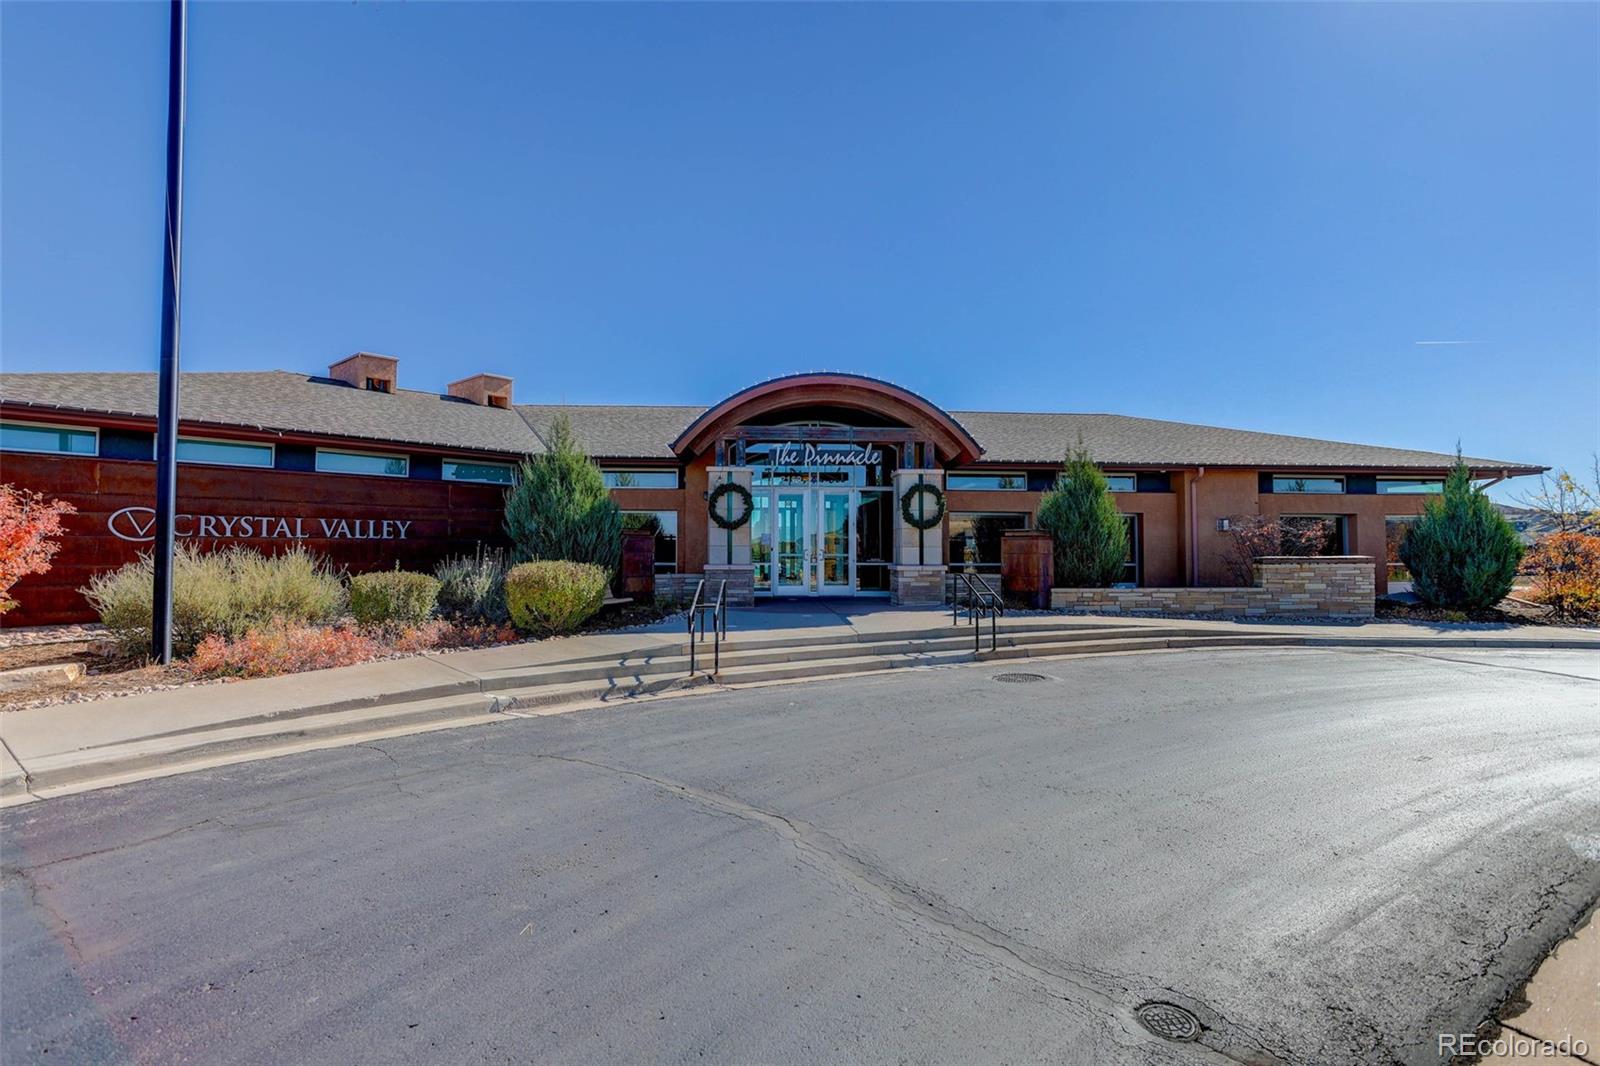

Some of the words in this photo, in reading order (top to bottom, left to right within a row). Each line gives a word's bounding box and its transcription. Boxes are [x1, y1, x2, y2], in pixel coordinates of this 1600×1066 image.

[772, 441, 799, 467] The
[804, 442, 881, 467] Pinnacle
[174, 514, 309, 539] CRYSTAL
[319, 518, 412, 540] VALLEY
